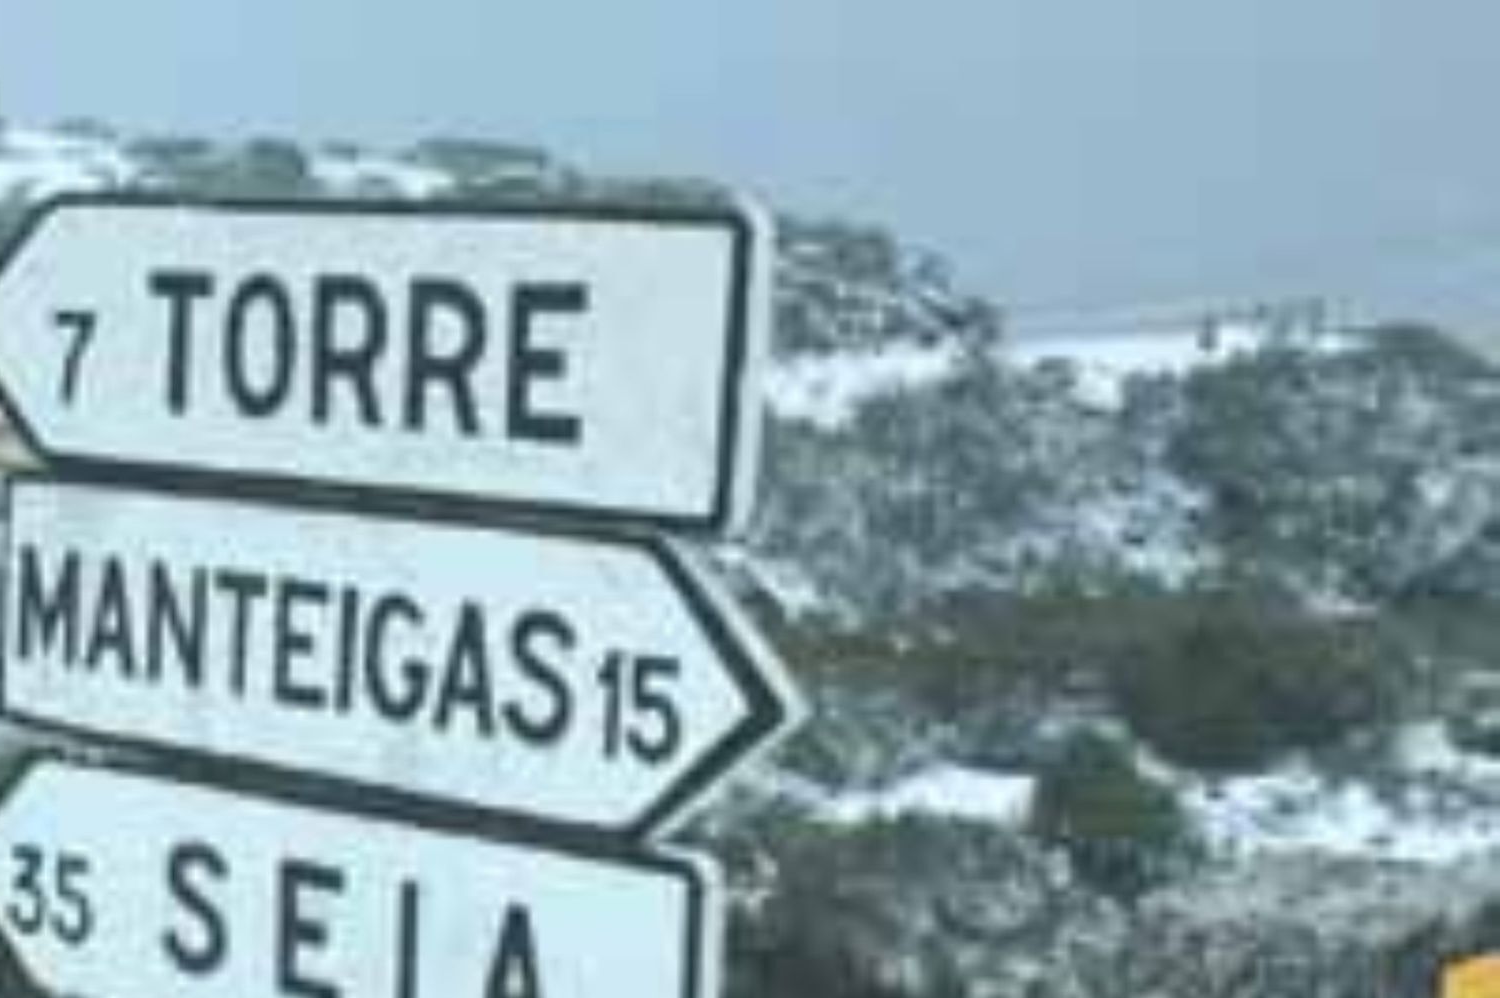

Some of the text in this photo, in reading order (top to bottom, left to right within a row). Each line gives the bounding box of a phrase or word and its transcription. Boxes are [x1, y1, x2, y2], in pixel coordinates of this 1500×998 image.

[54, 270, 588, 445] 7 TORRE
[15, 544, 682, 765] MANTEIGAS 15
[6, 845, 95, 947] 35
